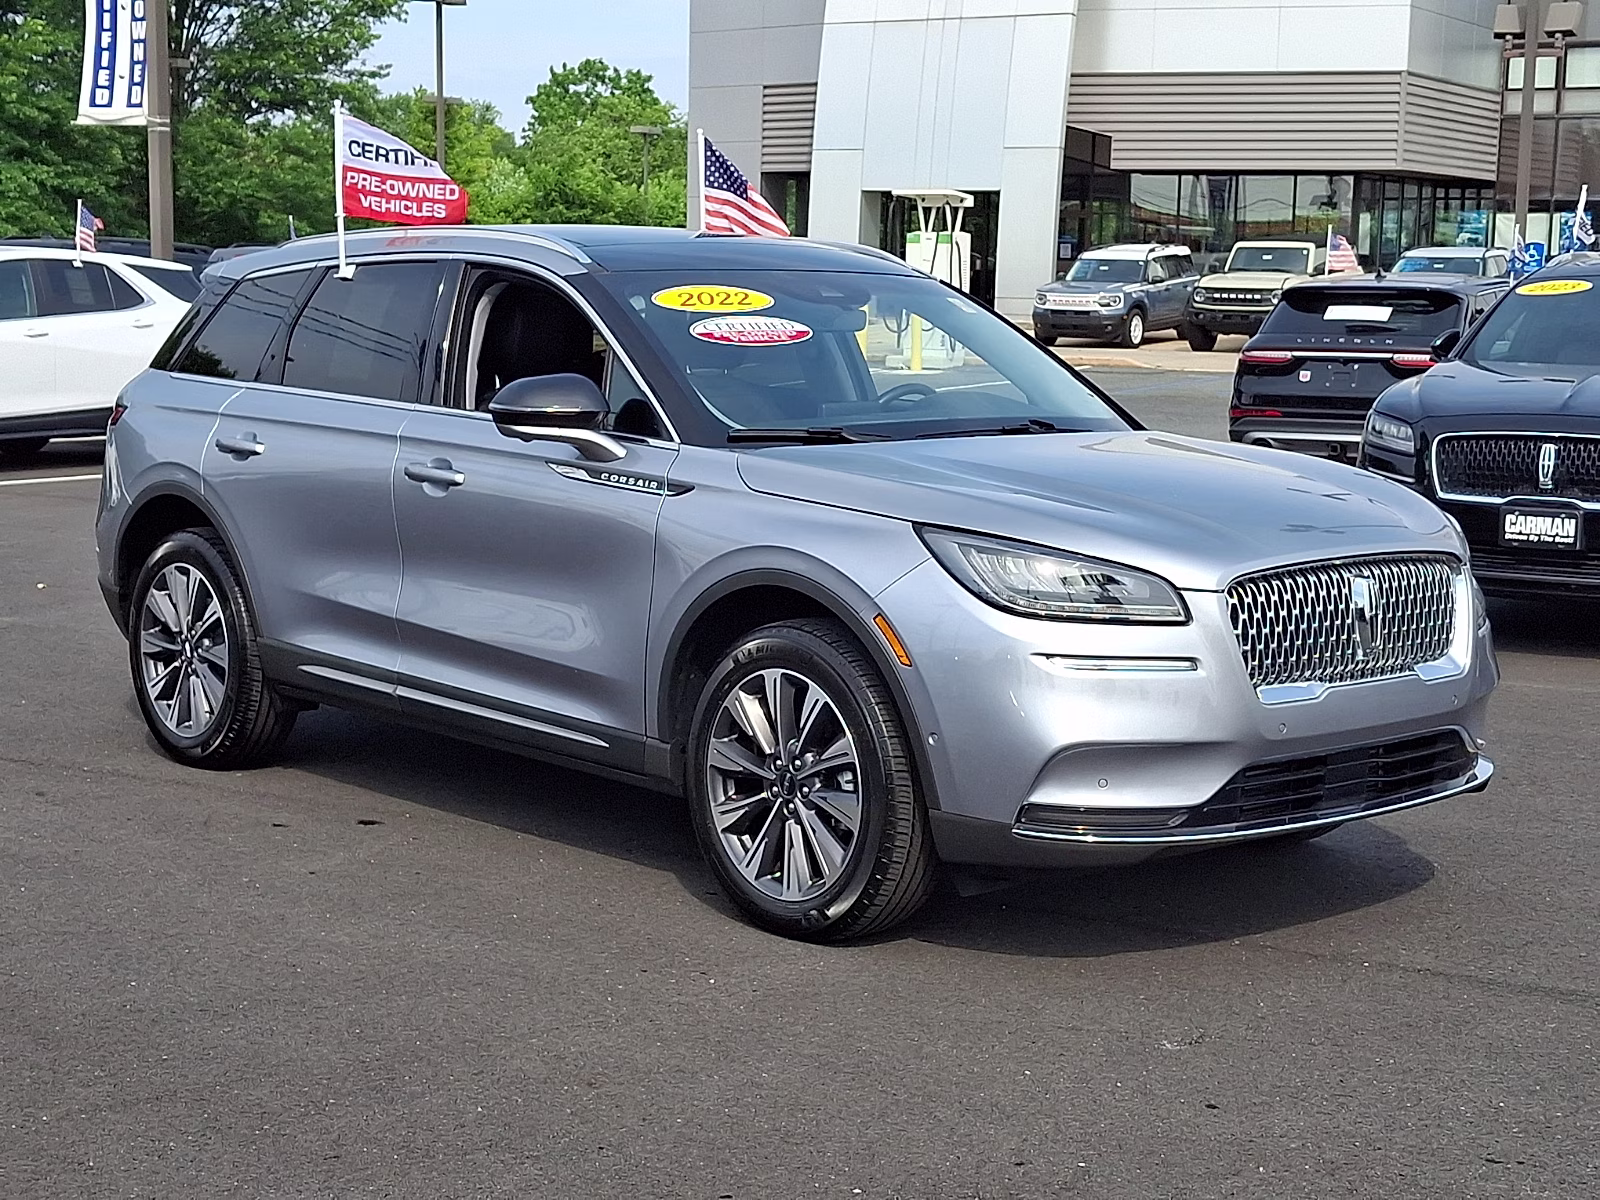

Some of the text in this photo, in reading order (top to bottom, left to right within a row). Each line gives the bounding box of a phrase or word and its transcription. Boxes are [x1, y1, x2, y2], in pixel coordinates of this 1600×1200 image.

[345, 171, 459, 200] PRE-OWNED
[359, 193, 446, 218] VEHICLES
[677, 291, 752, 306] 2022
[600, 472, 659, 489] CORSAIR
[1504, 513, 1576, 537] CARMAN
